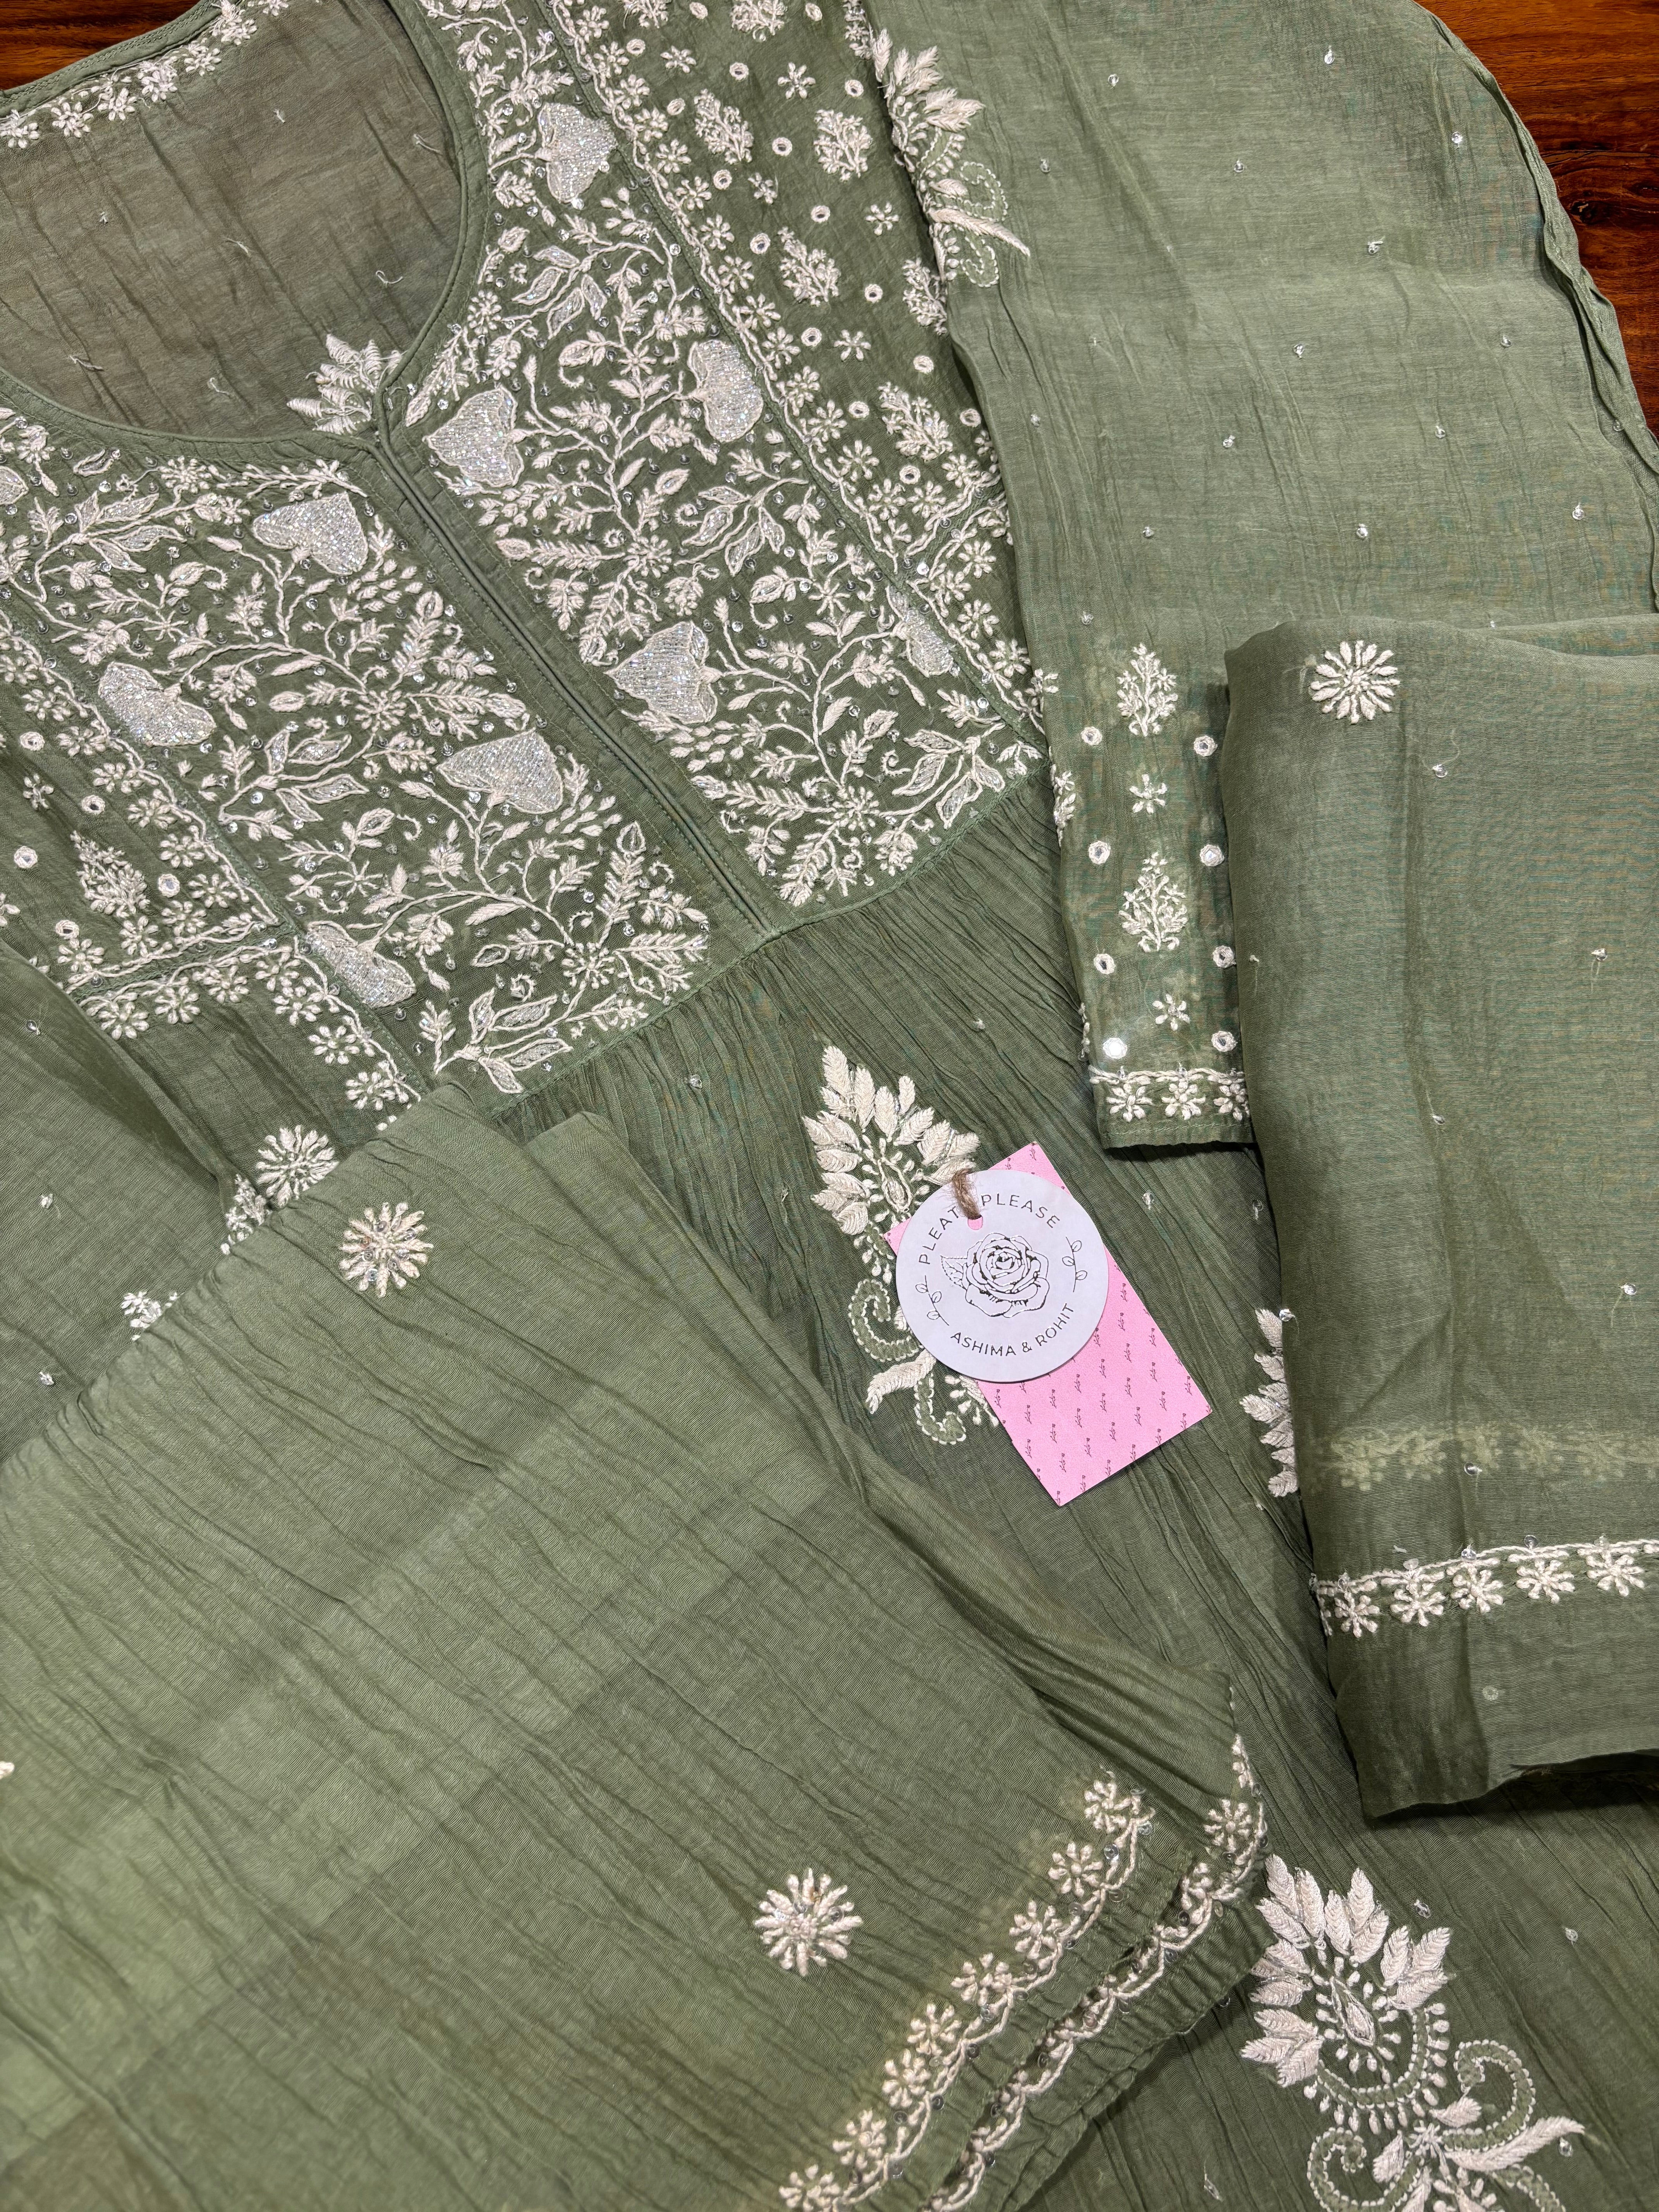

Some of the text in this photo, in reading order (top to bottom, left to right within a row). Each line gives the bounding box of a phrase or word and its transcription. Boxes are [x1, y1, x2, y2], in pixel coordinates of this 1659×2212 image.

[981, 1194, 1060, 1229] PLEASE
[950, 1303, 1075, 1357] ASHIMA & ROHIT
